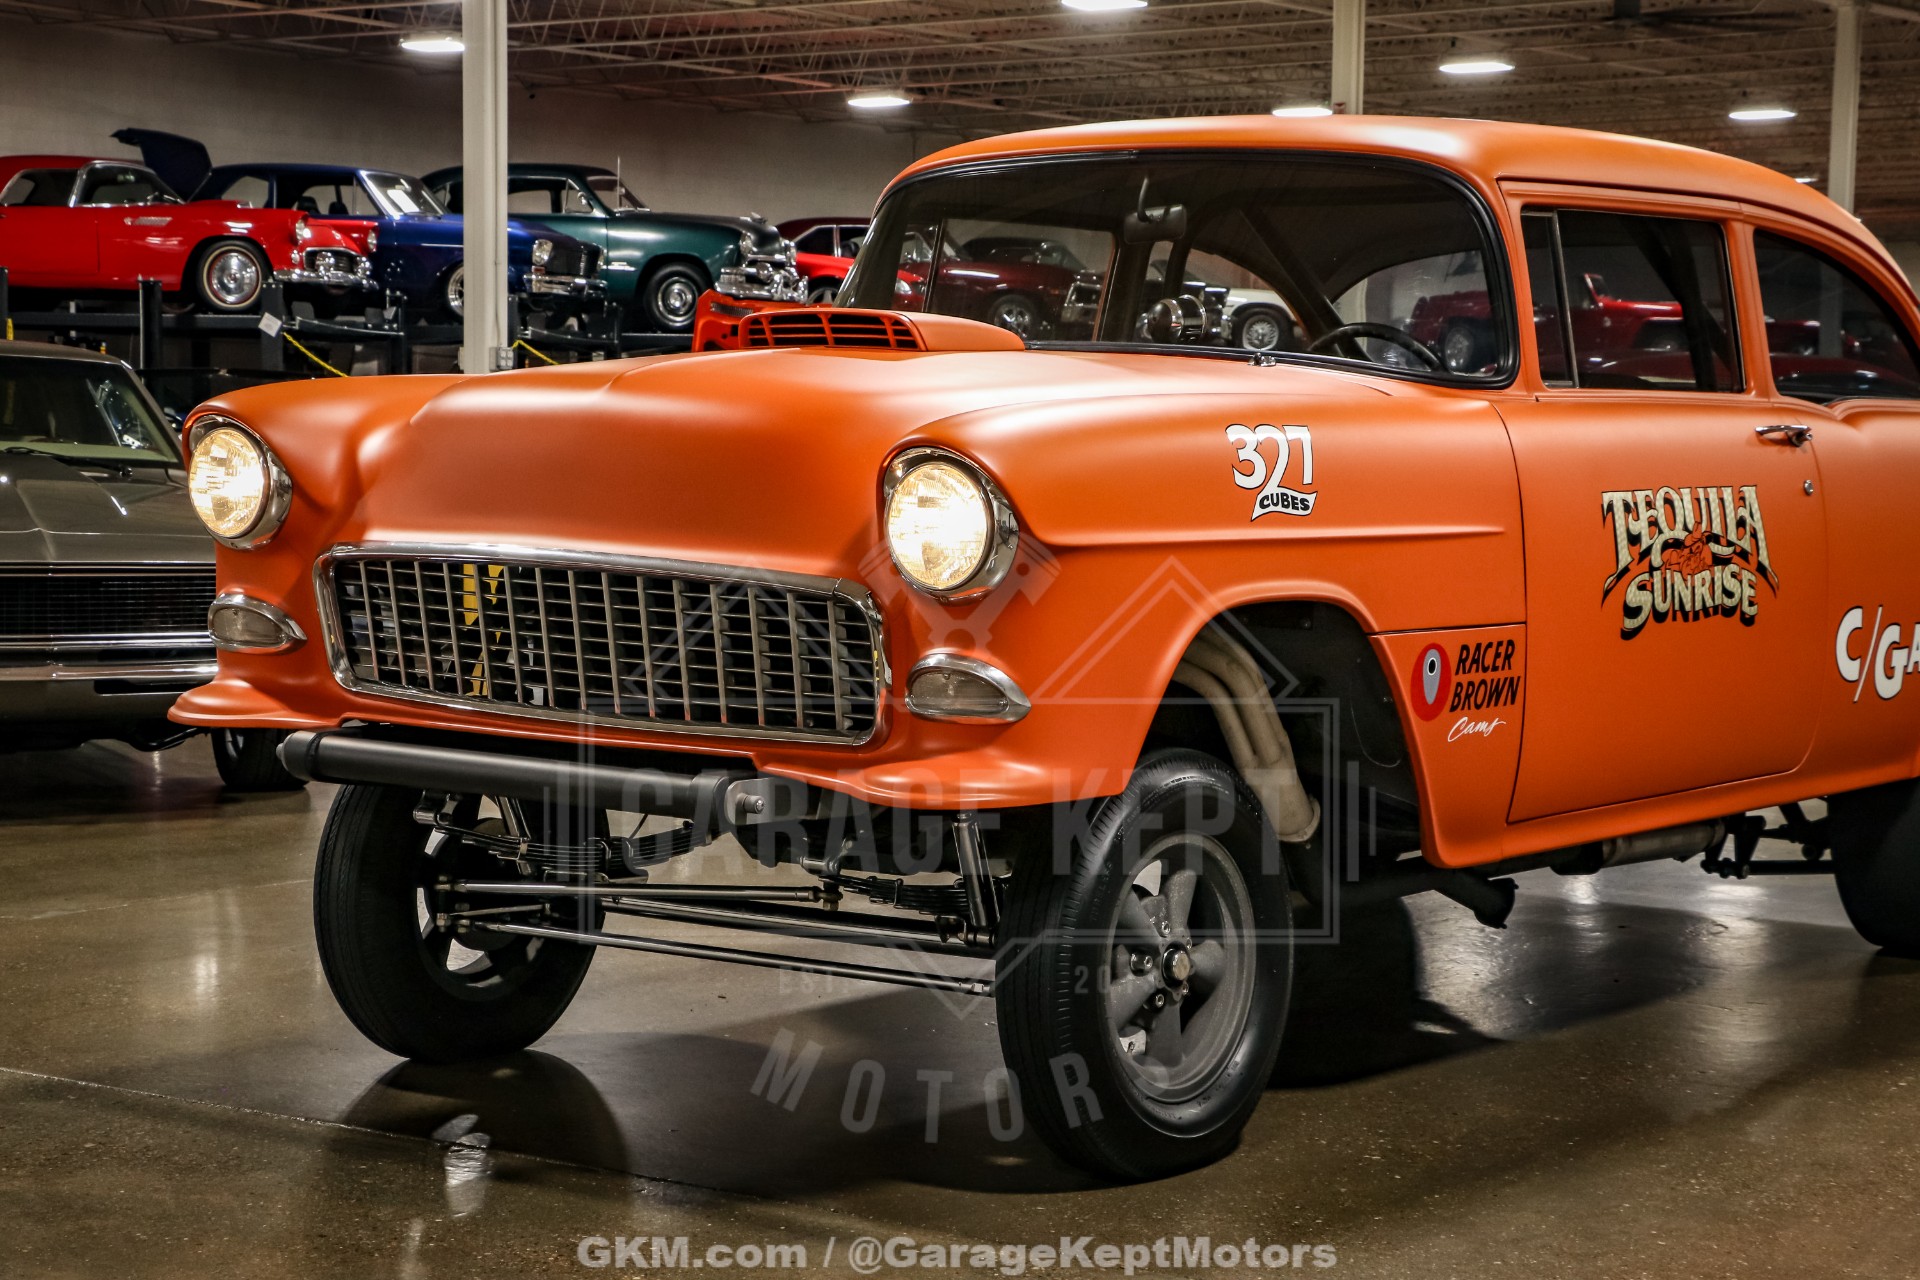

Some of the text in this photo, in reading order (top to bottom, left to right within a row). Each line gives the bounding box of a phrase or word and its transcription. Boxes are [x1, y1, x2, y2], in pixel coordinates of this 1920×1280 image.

[1225, 423, 1316, 521] 327
[1258, 492, 1310, 511] CUBES
[1601, 485, 1779, 612] TEQUILA
[1620, 563, 1759, 641] SUNRISE
[1455, 639, 1516, 676] RACER
[1449, 676, 1521, 713] BROWN
[1448, 717, 1506, 742] Cams
